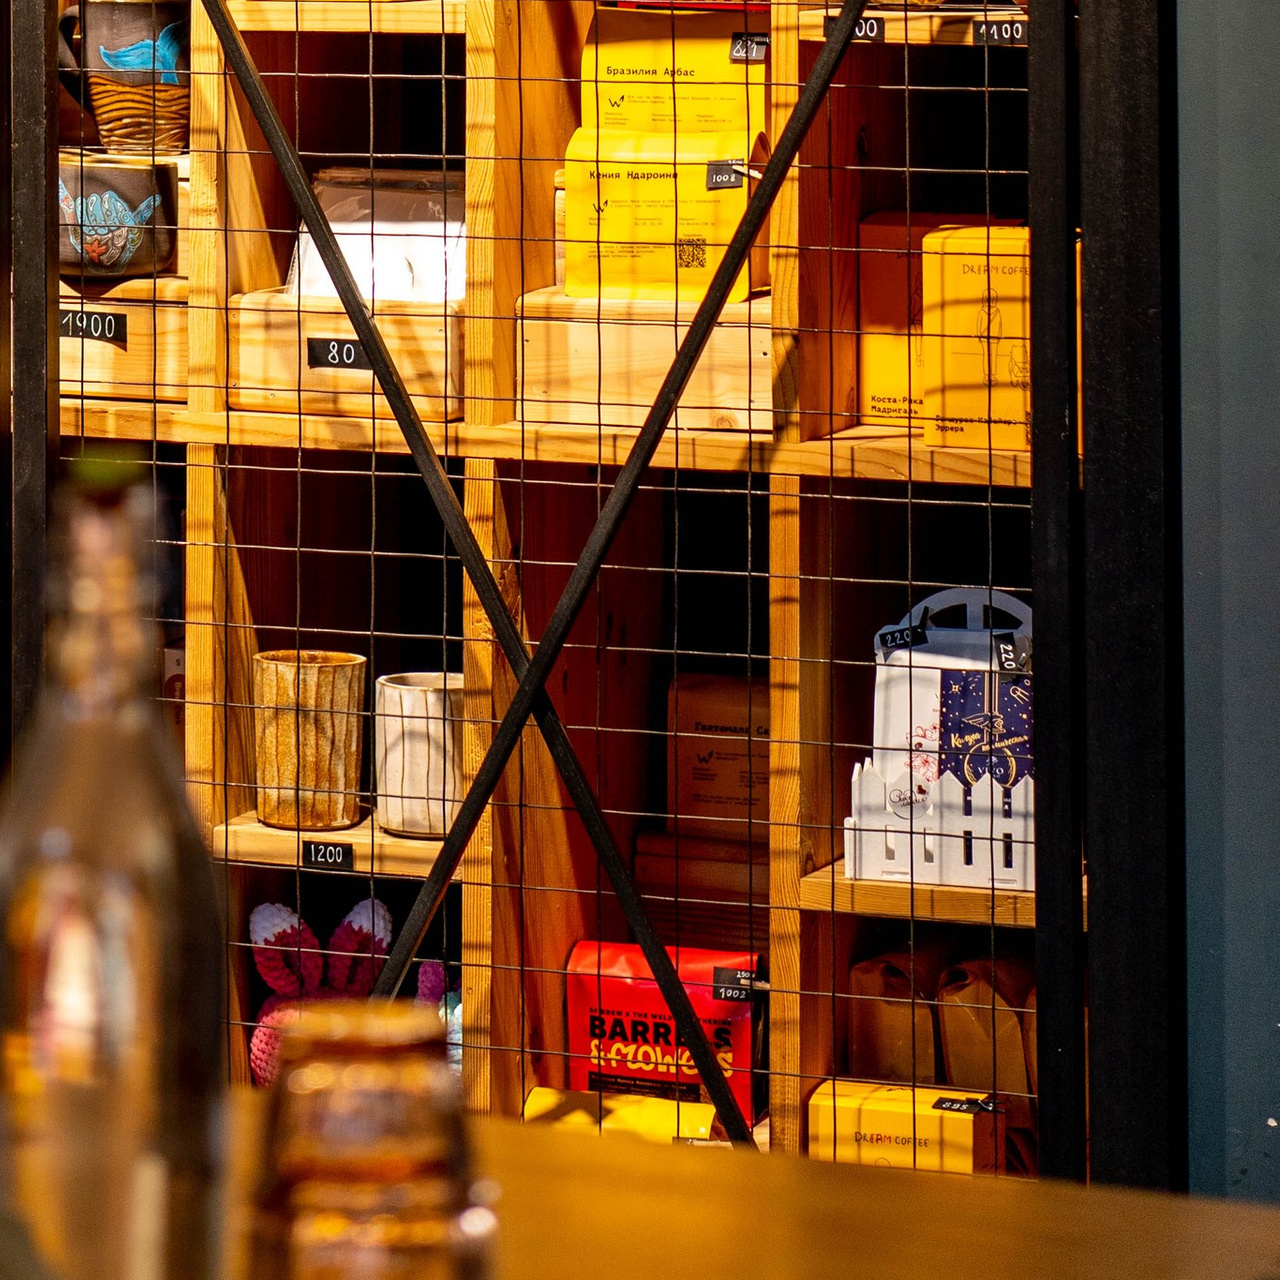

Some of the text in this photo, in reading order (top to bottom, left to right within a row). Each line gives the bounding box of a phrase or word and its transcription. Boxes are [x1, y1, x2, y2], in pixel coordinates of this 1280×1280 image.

[980, 23, 1022, 39] 1100
[606, 65, 696, 78] Бразилия Арбас
[589, 170, 621, 179] Кения
[61, 312, 115, 337] 1900
[328, 341, 355, 364] 80
[886, 630, 911, 647] 220
[1000, 644, 1016, 669] 220
[311, 842, 343, 863] 1200
[720, 988, 746, 998] 1002
